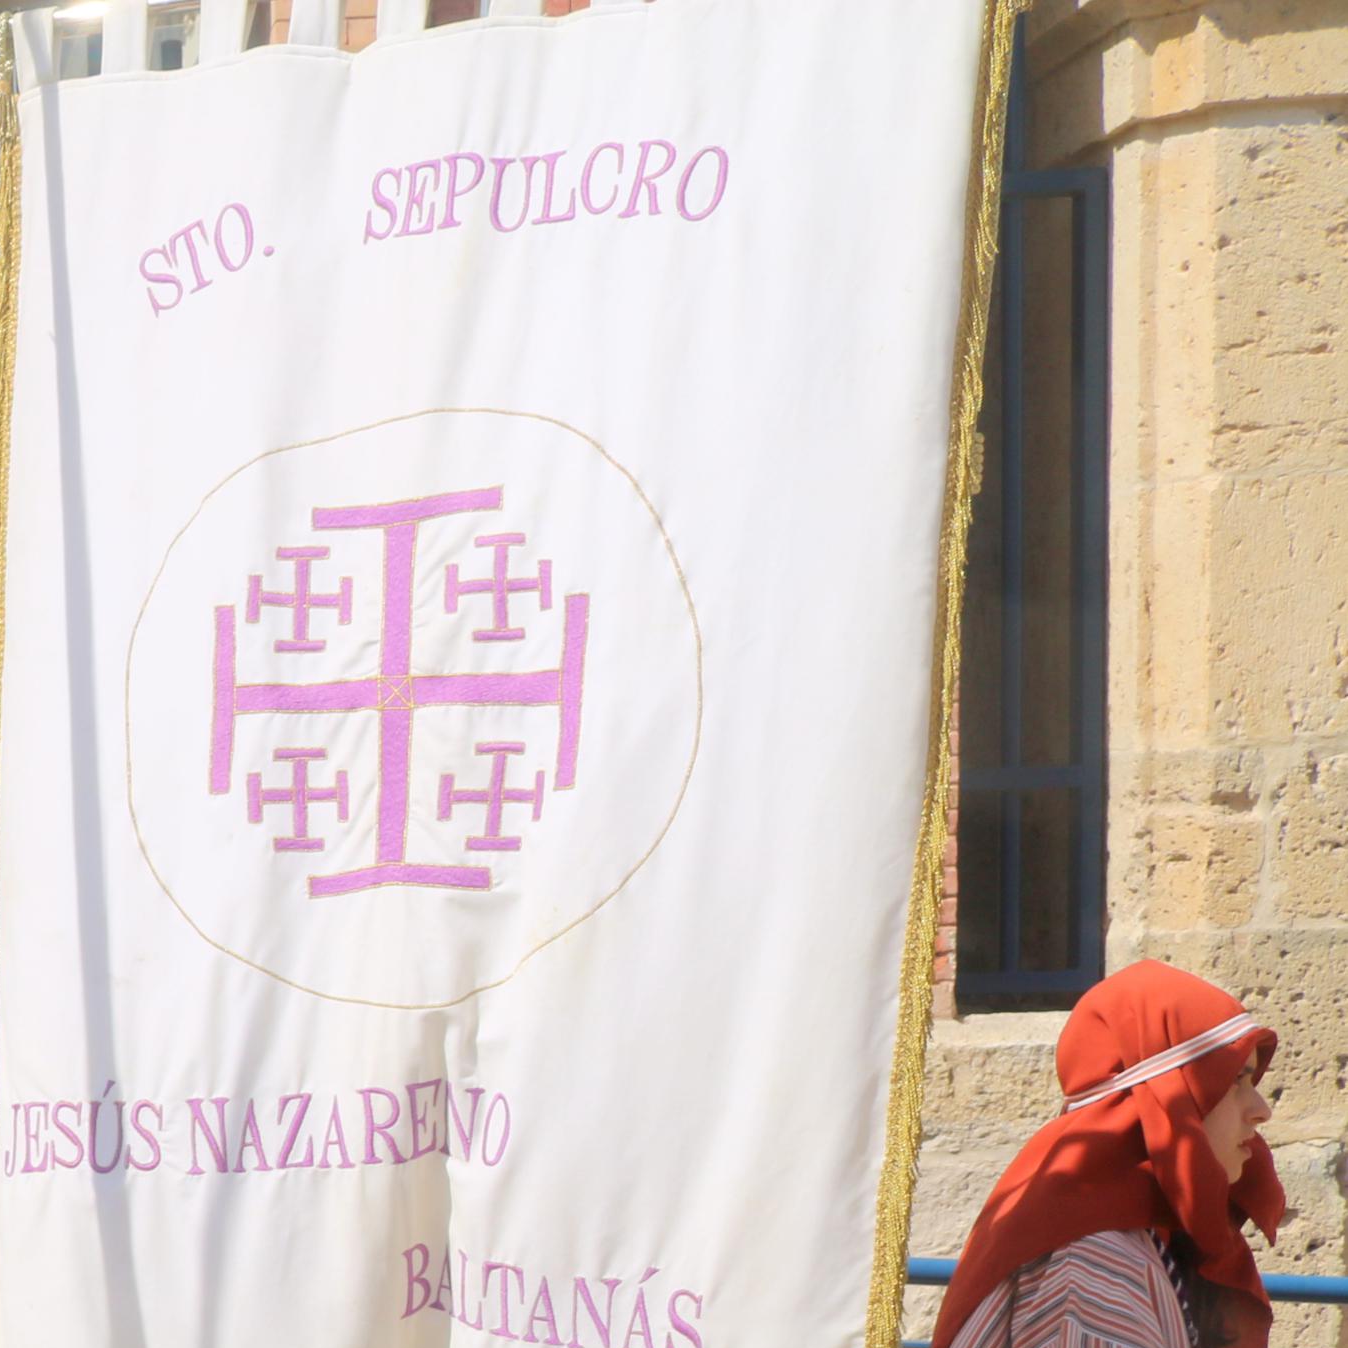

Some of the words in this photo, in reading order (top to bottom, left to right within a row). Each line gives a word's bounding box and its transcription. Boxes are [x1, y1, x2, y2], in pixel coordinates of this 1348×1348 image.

[139, 203, 275, 317] STO.
[363, 139, 730, 245] SEPULCRO
[4, 1080, 163, 1177] JESÚS
[186, 1078, 511, 1176] NAZARENO
